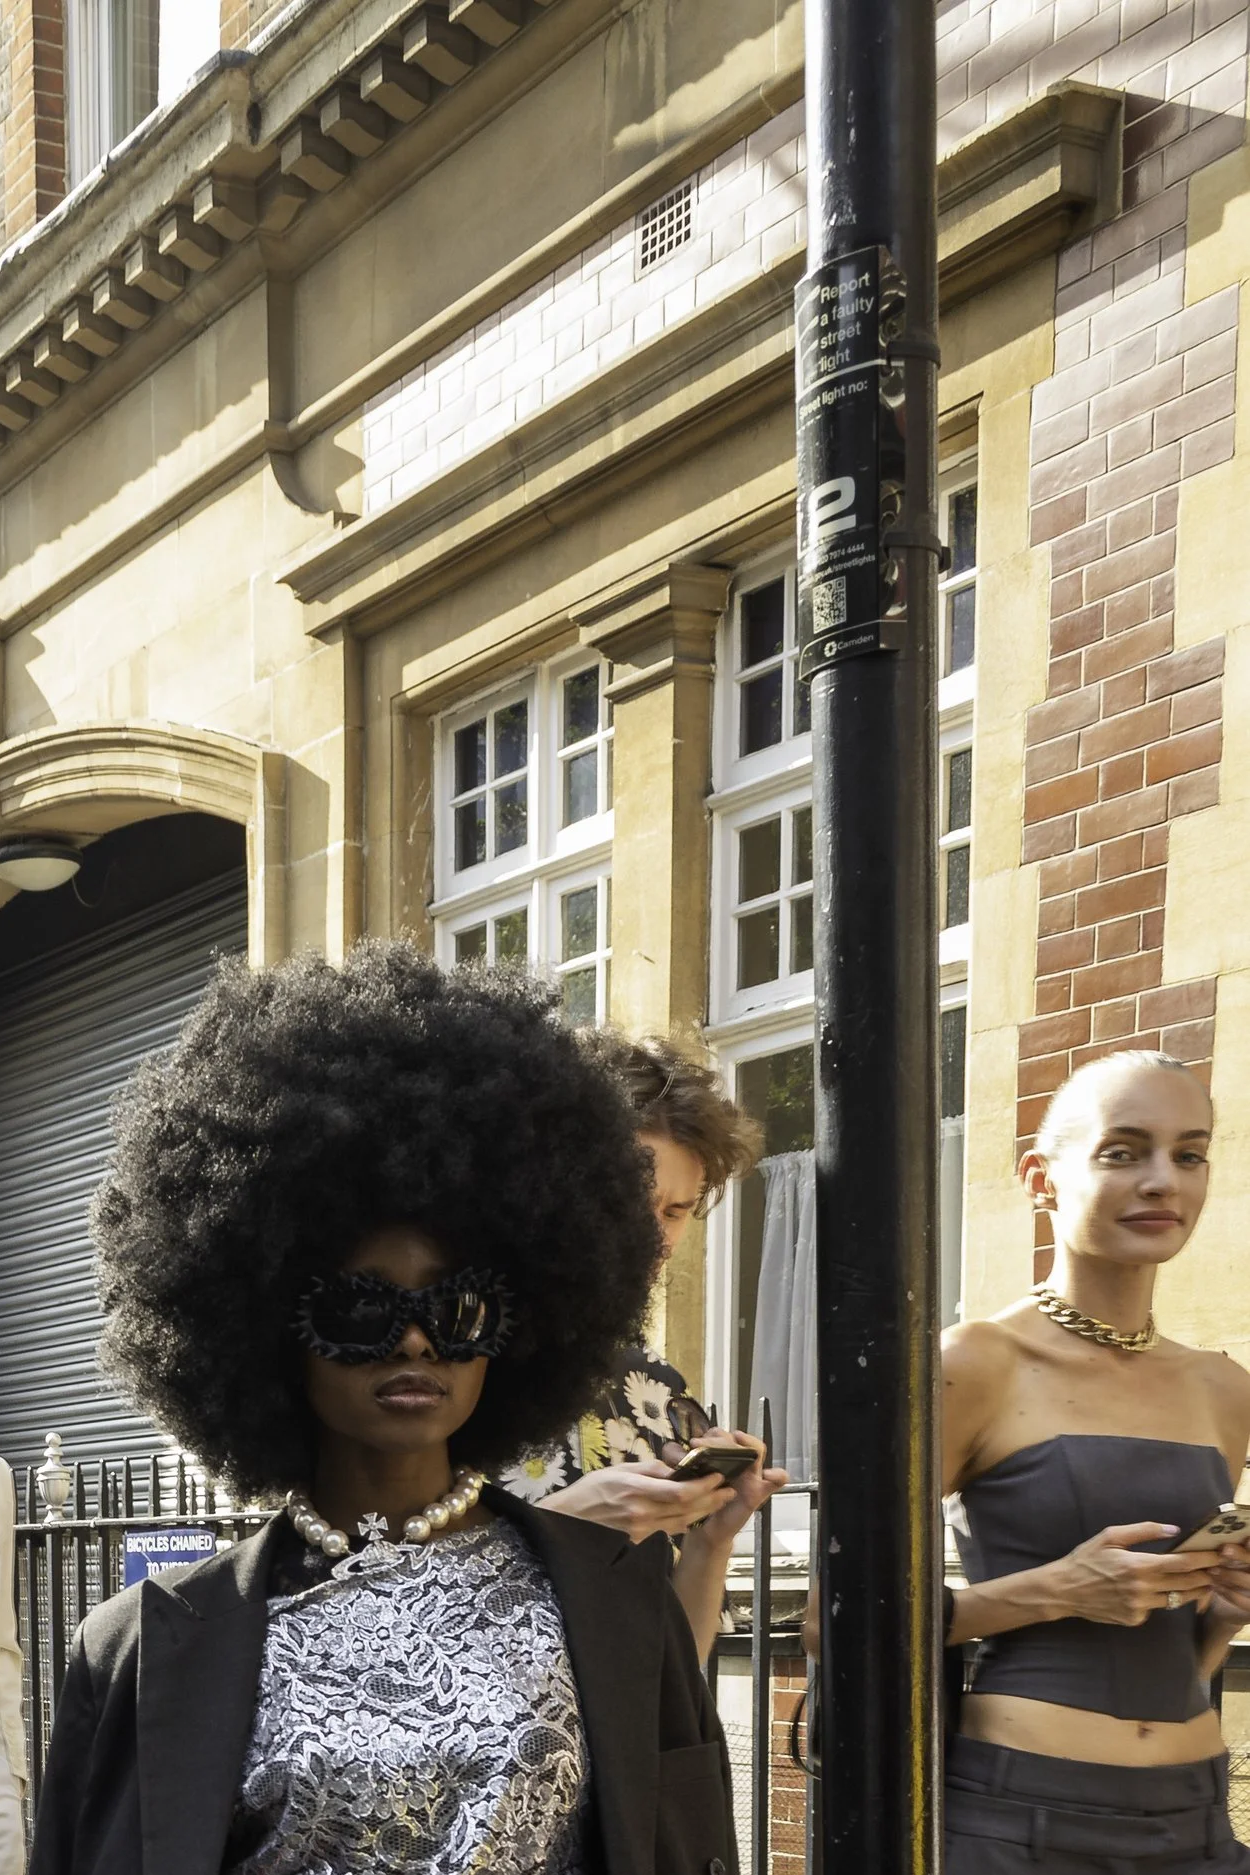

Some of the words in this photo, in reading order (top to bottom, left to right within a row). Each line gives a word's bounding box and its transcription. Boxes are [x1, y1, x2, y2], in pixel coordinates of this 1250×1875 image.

[820, 272, 871, 304] Report
[820, 313, 829, 327] a
[831, 296, 875, 321] faulty
[820, 321, 862, 349] street
[820, 347, 851, 372] light
[822, 384, 846, 405] light
[848, 380, 868, 395] no:
[808, 475, 857, 542] 2
[837, 634, 875, 650] Camden
[126, 1535, 170, 1553] BICYCLES
[170, 1534, 213, 1552] CHAINED
[146, 1561, 160, 1577] TO
